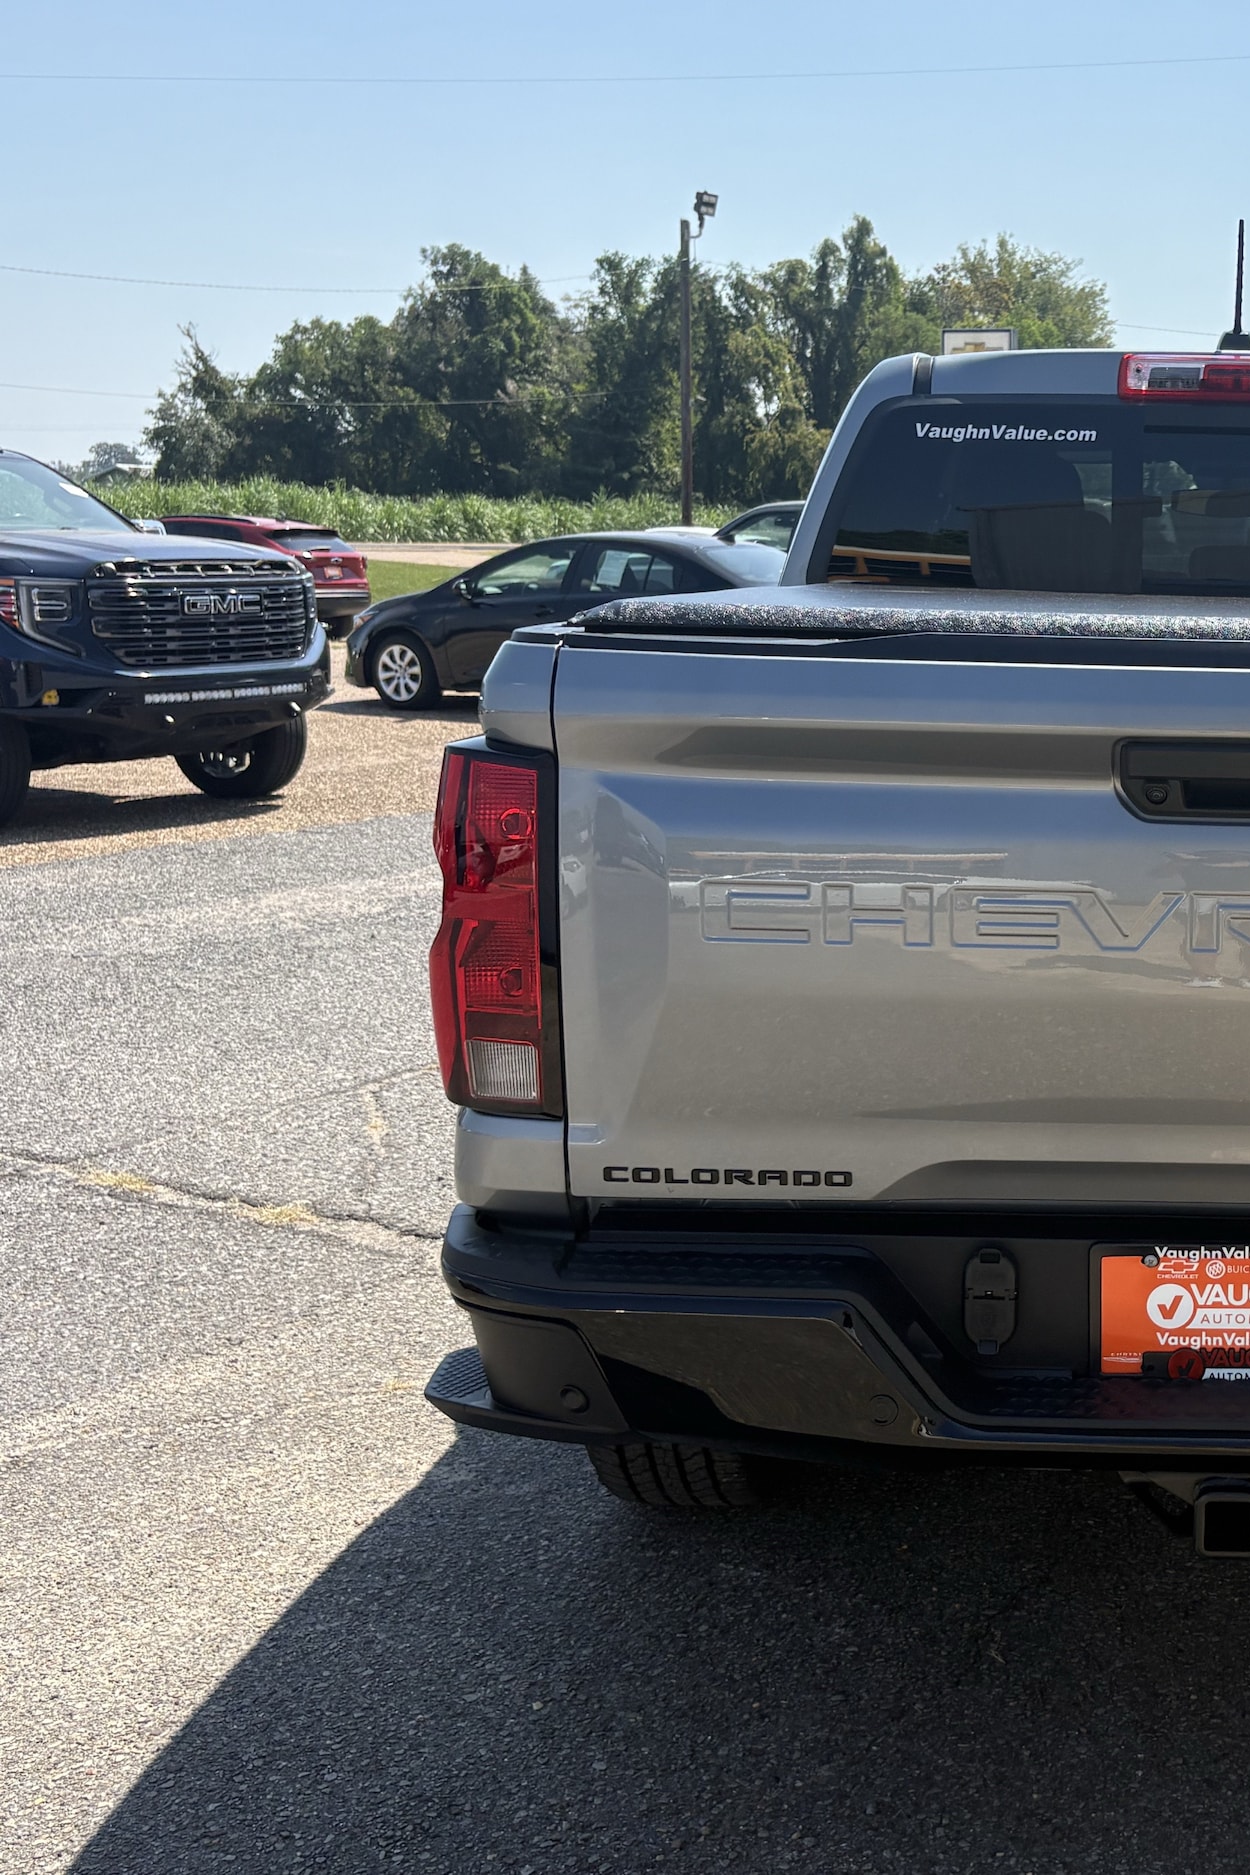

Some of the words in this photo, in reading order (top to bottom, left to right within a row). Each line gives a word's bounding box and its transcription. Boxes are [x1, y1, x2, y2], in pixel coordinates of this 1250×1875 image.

[915, 423, 1097, 442] VaughnValue.com
[185, 594, 261, 615] GMC
[603, 1166, 852, 1187] COLORADO
